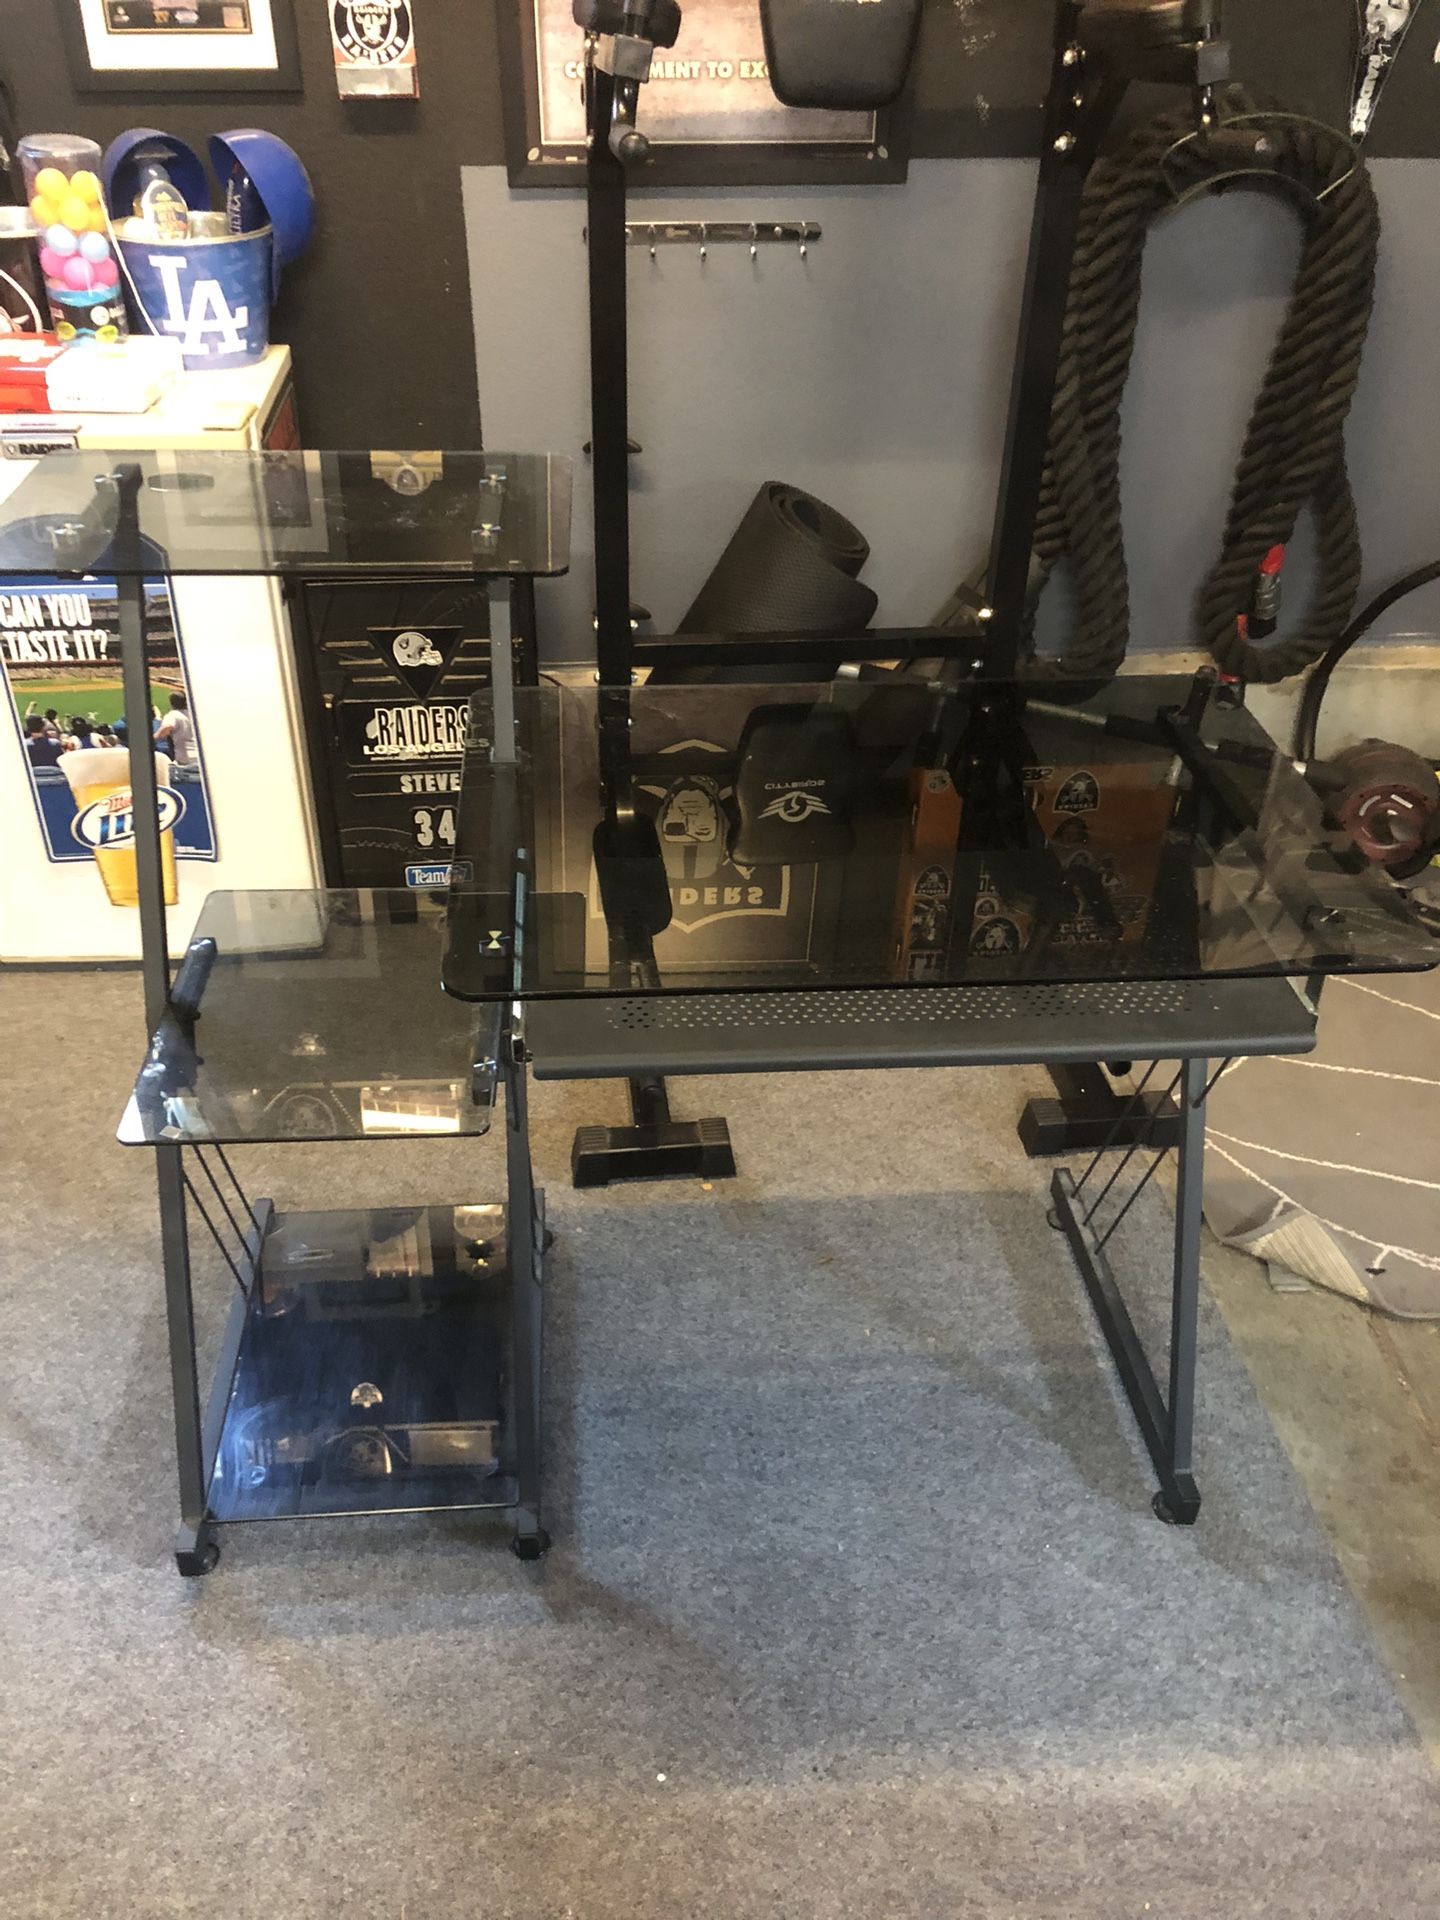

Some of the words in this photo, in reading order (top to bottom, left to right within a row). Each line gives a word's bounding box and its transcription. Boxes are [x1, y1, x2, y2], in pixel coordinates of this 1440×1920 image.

[706, 61, 733, 78] TO
[149, 255, 249, 356] LA
[0, 594, 45, 628] CAN
[41, 593, 93, 627] YOU
[4, 631, 72, 663] TASTE
[72, 628, 110, 661] IT?
[374, 705, 472, 748] RAIDERS
[362, 744, 400, 756] LOS
[400, 772, 463, 794] STEVE
[413, 808, 458, 847] 34
[412, 868, 446, 885] Team
